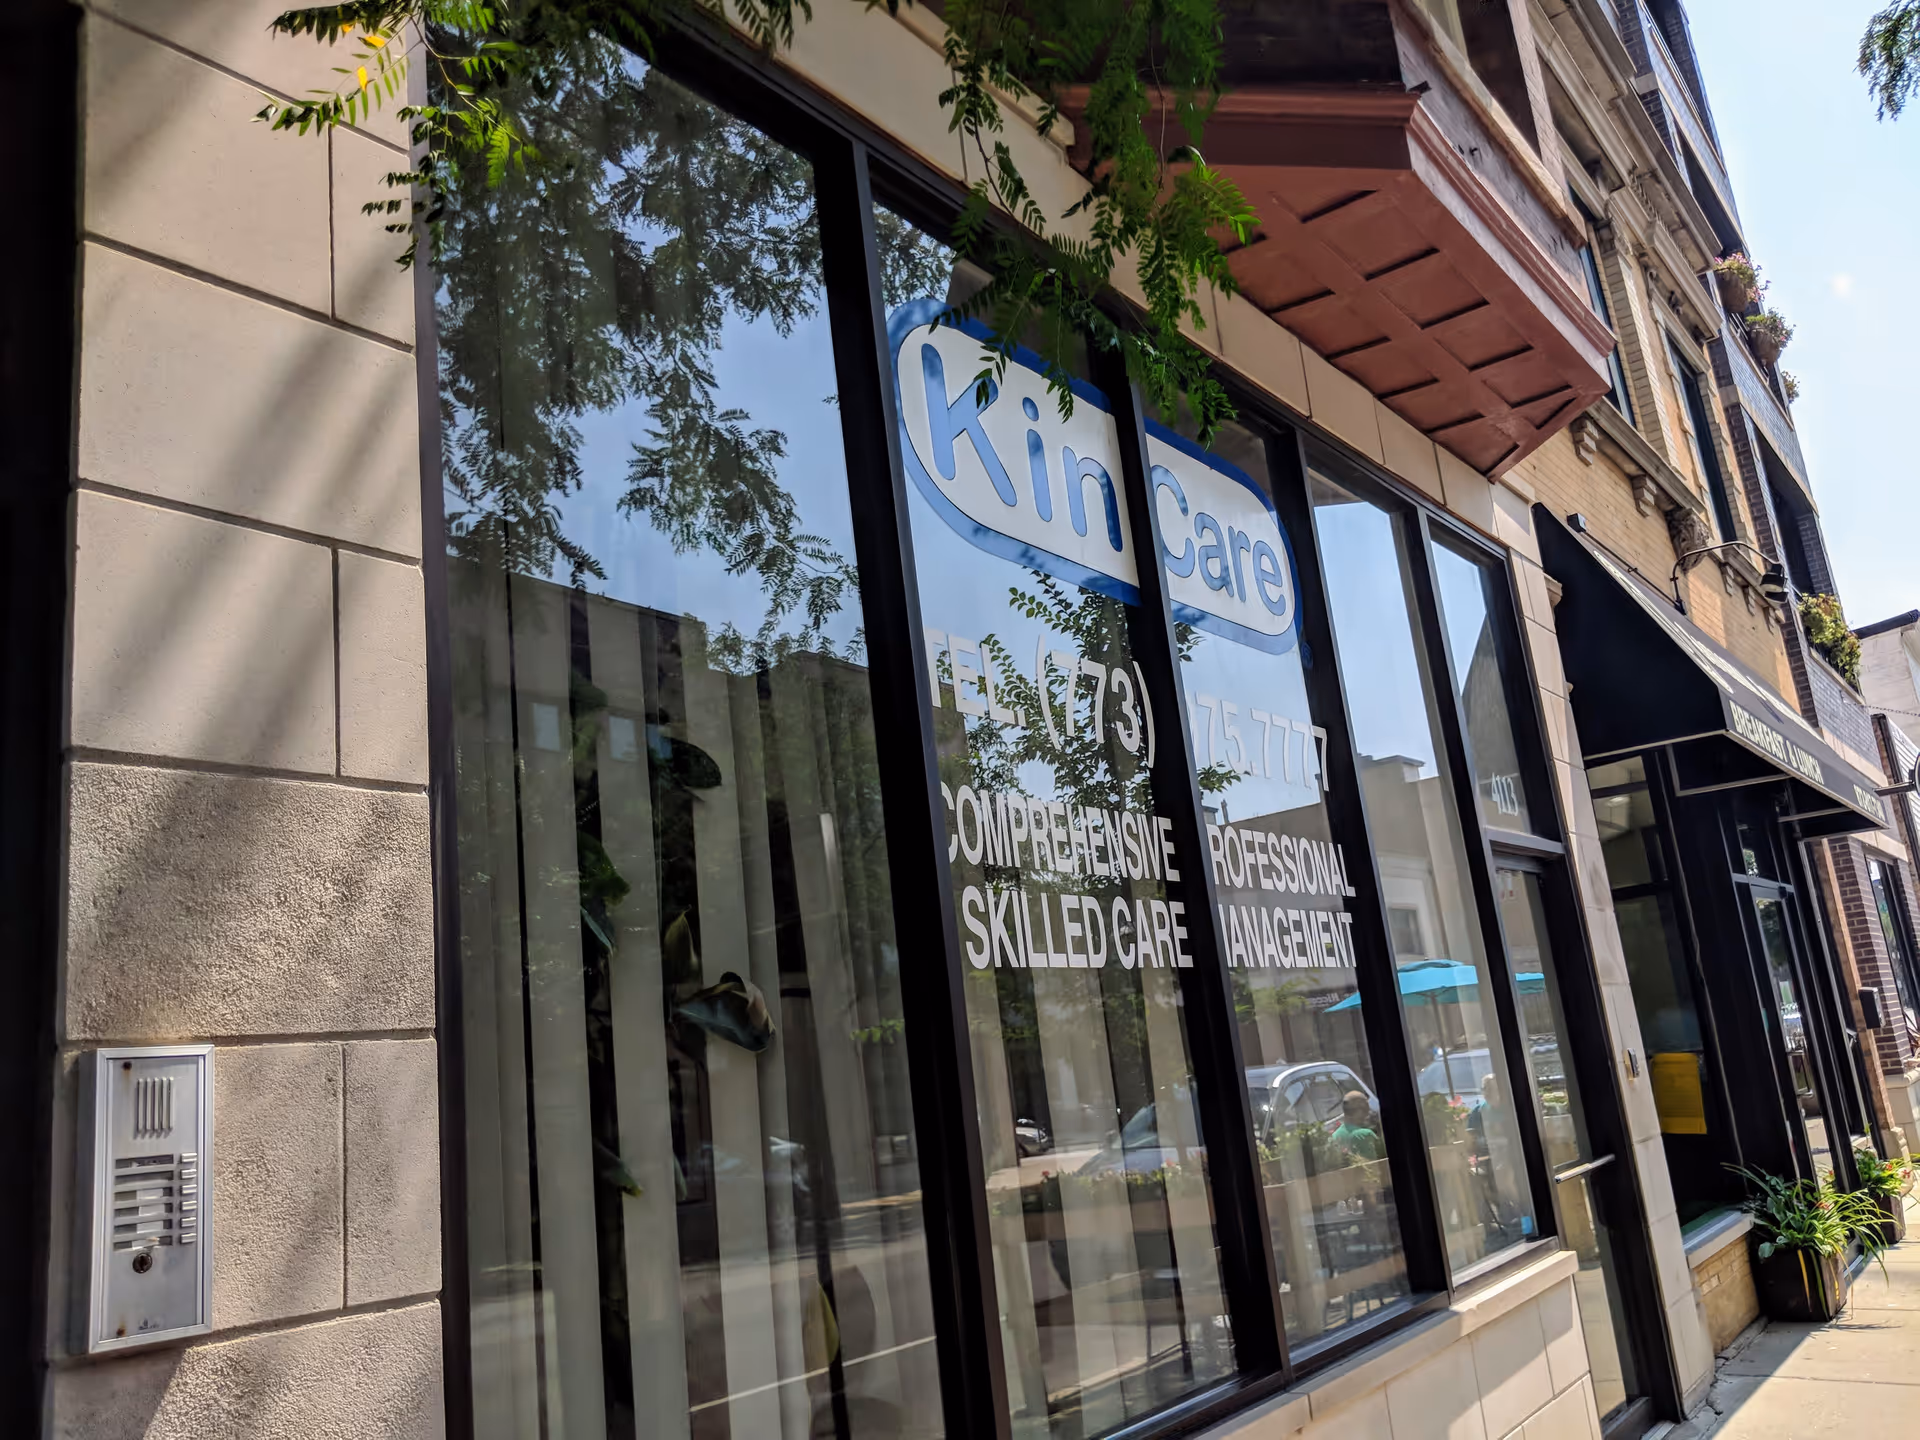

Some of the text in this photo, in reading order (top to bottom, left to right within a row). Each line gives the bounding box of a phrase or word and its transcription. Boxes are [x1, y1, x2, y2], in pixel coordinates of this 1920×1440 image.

[924, 627, 1026, 727] TEL.
[1036, 634, 1156, 768] (773)
[1729, 700, 1825, 785] BREAKFAST & LUNCH
[1206, 824, 1356, 897] ROFESSIONAL
[962, 885, 1357, 970] SKILLED CARE ANAGEMENT
